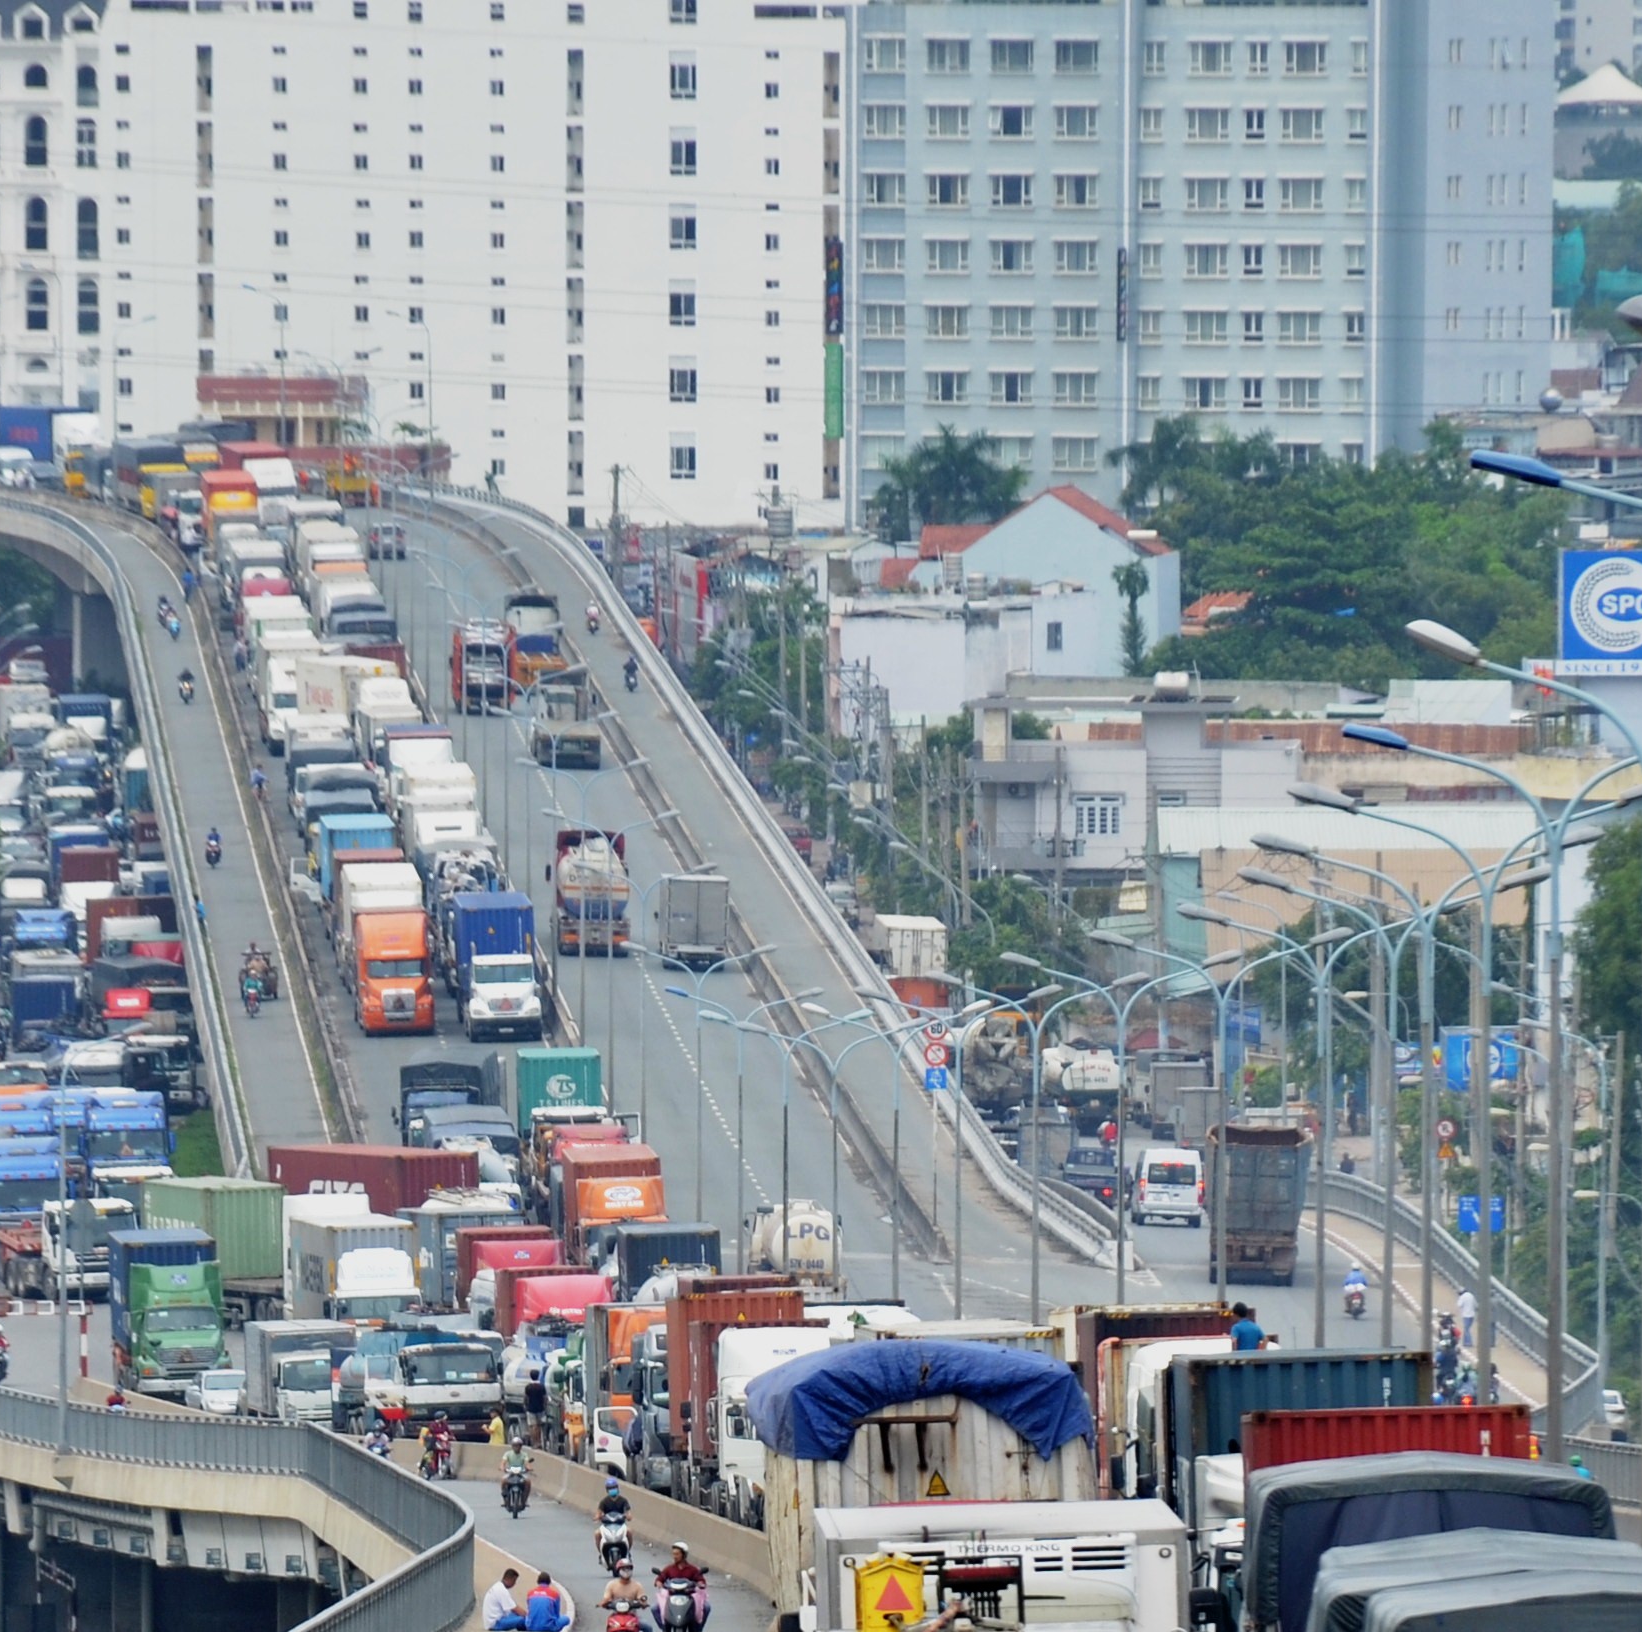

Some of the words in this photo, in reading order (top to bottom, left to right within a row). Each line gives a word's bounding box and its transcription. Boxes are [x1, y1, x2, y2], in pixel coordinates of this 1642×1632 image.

[1564, 662, 1615, 673] SINCE
[786, 1222, 830, 1241] LPG
[958, 1544, 1021, 1554] THERMO
[1024, 1543, 1061, 1552] KING
